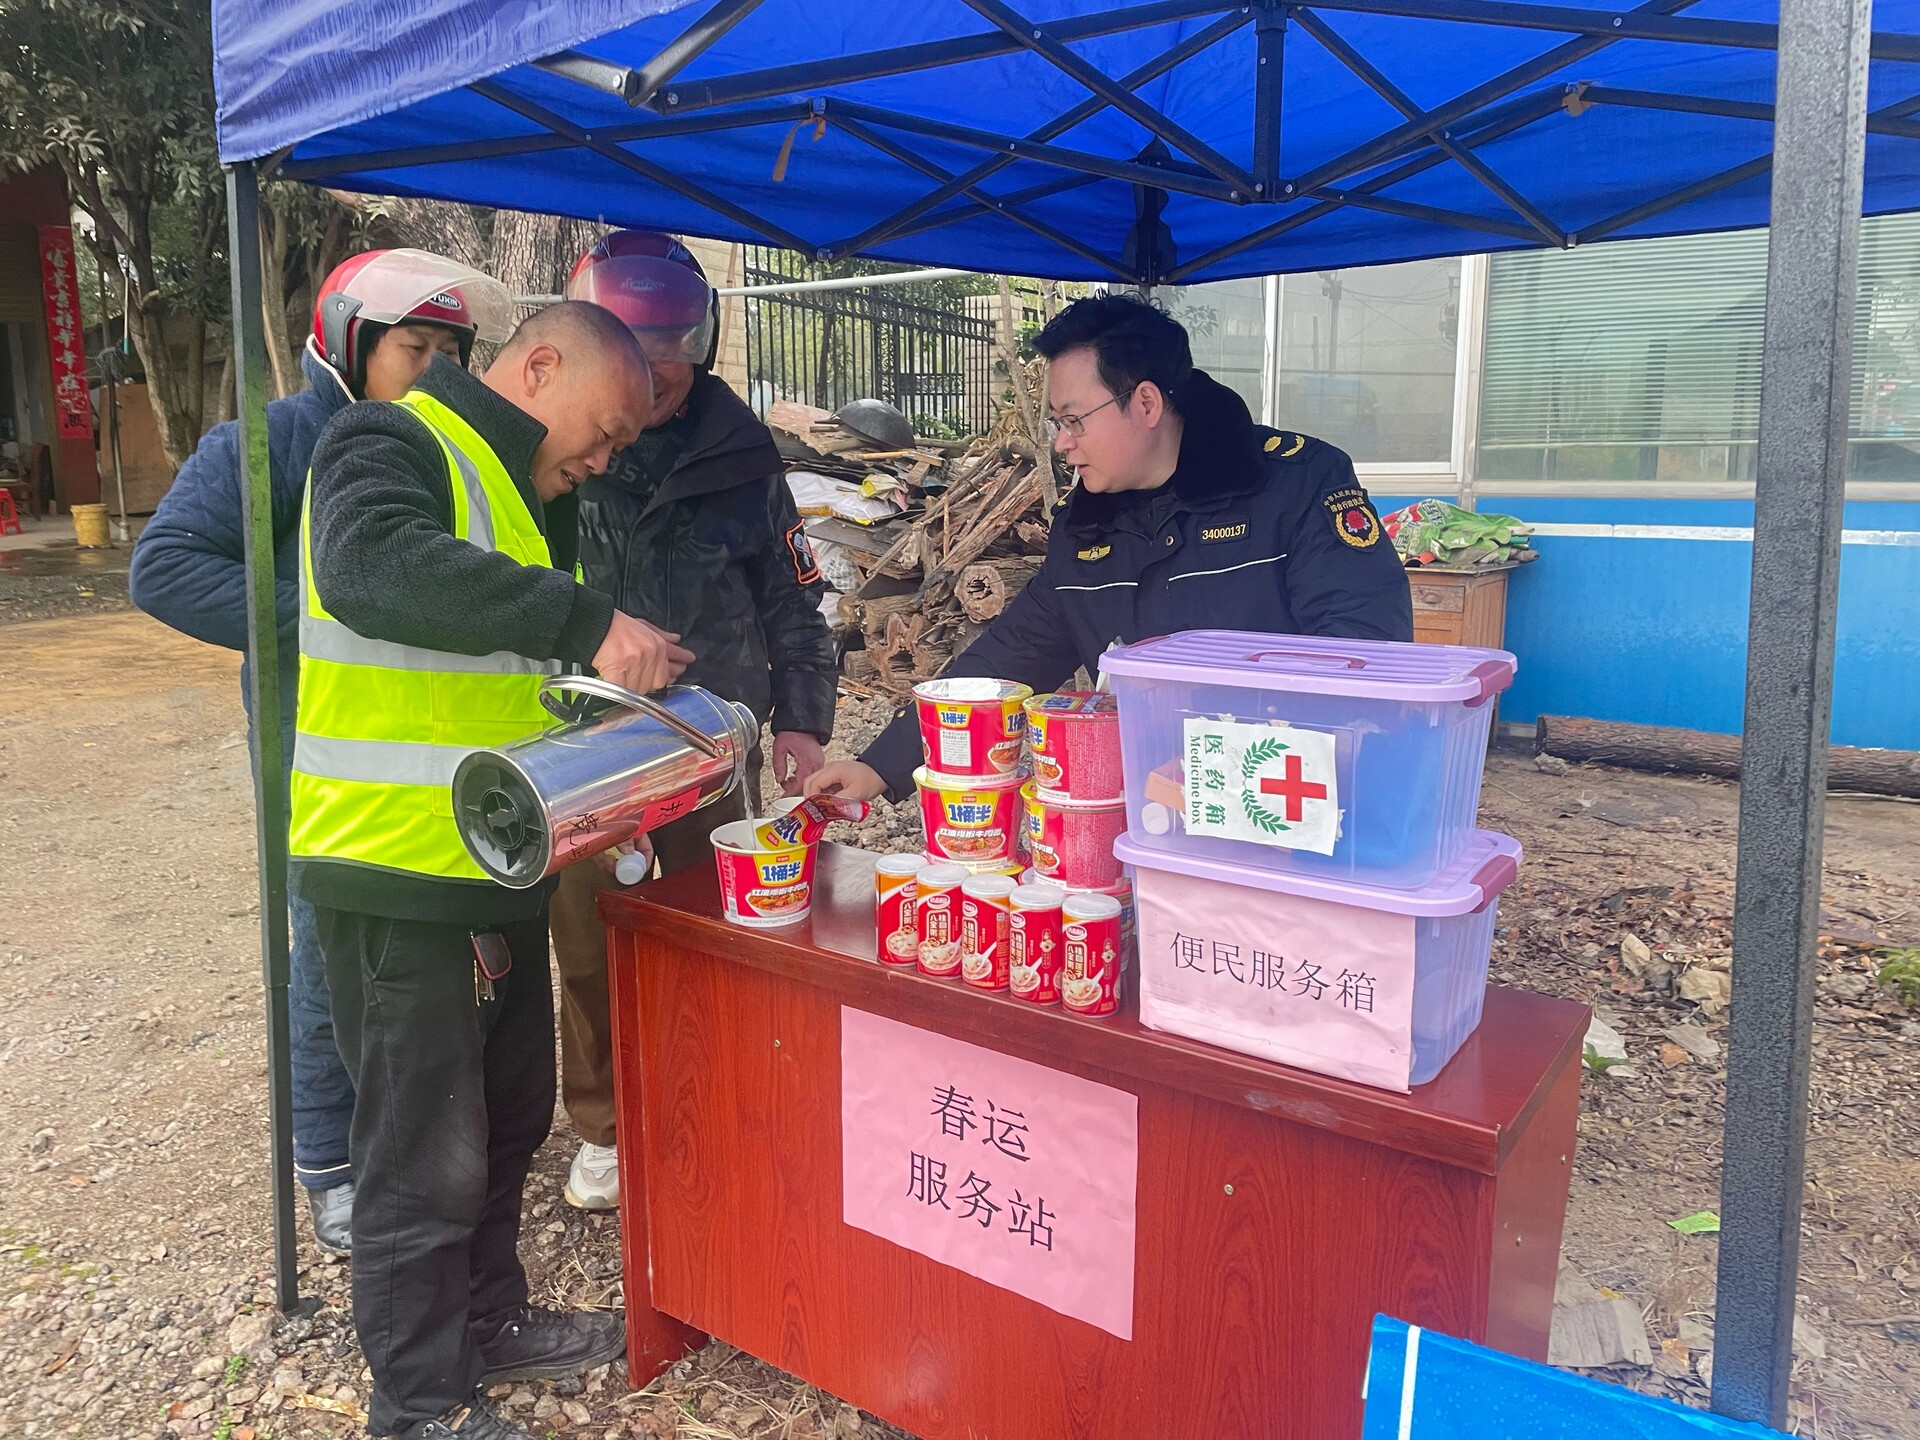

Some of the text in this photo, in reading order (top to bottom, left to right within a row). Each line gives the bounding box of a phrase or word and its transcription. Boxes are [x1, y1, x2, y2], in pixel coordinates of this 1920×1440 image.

[1202, 523, 1246, 540] 34000137
[940, 711, 967, 725] 1桶半
[948, 803, 992, 824] 1桶半
[1190, 735, 1203, 825] Medicine box
[1204, 734, 1226, 826] 医药箱
[761, 861, 802, 882] 1桶半
[1170, 931, 1377, 1013] 便民服务箱
[930, 1085, 1031, 1162] 春运
[906, 1150, 1057, 1251] 服务站
